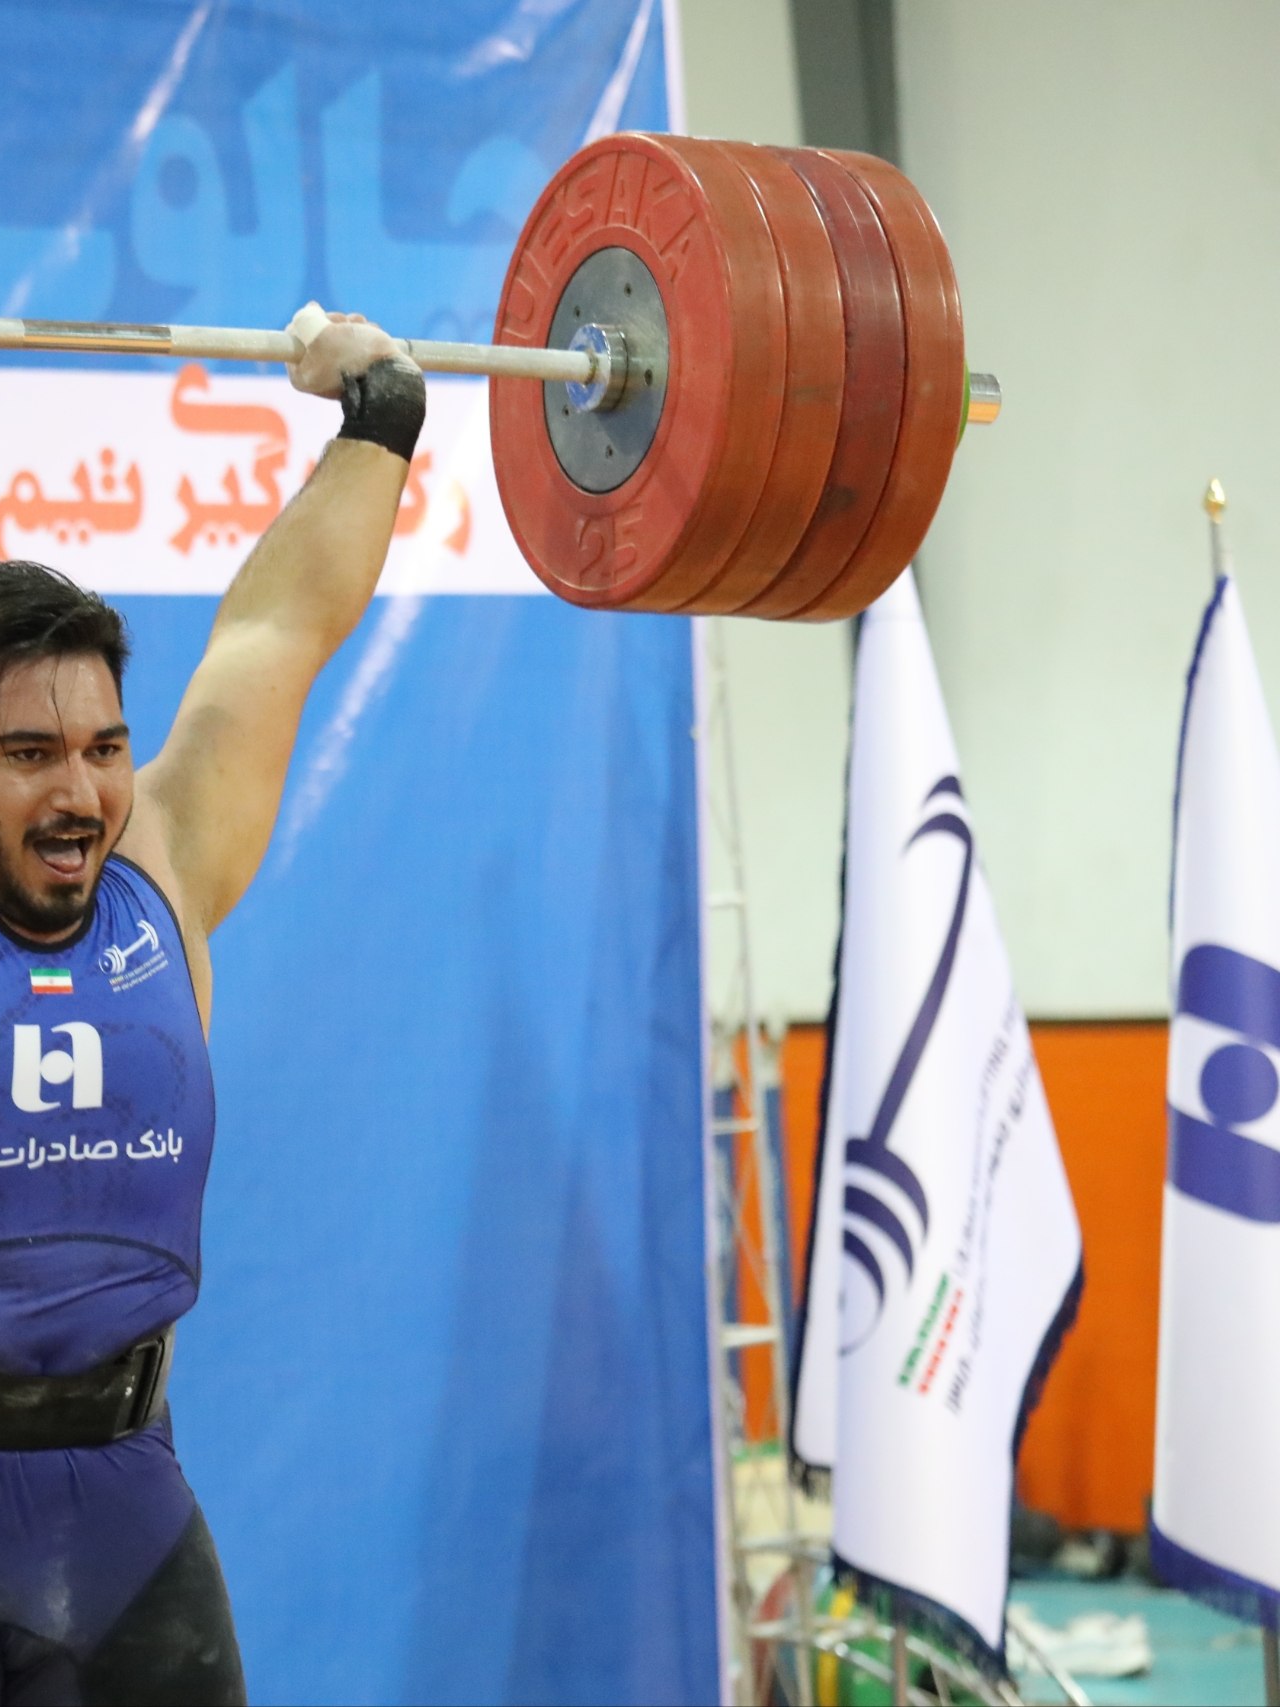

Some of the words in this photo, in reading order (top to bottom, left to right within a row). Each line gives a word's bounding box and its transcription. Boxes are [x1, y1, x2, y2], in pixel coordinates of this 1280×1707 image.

[502, 145, 696, 342] UESAKA
[575, 502, 643, 591] 25
[126, 1127, 183, 1164] بانک
